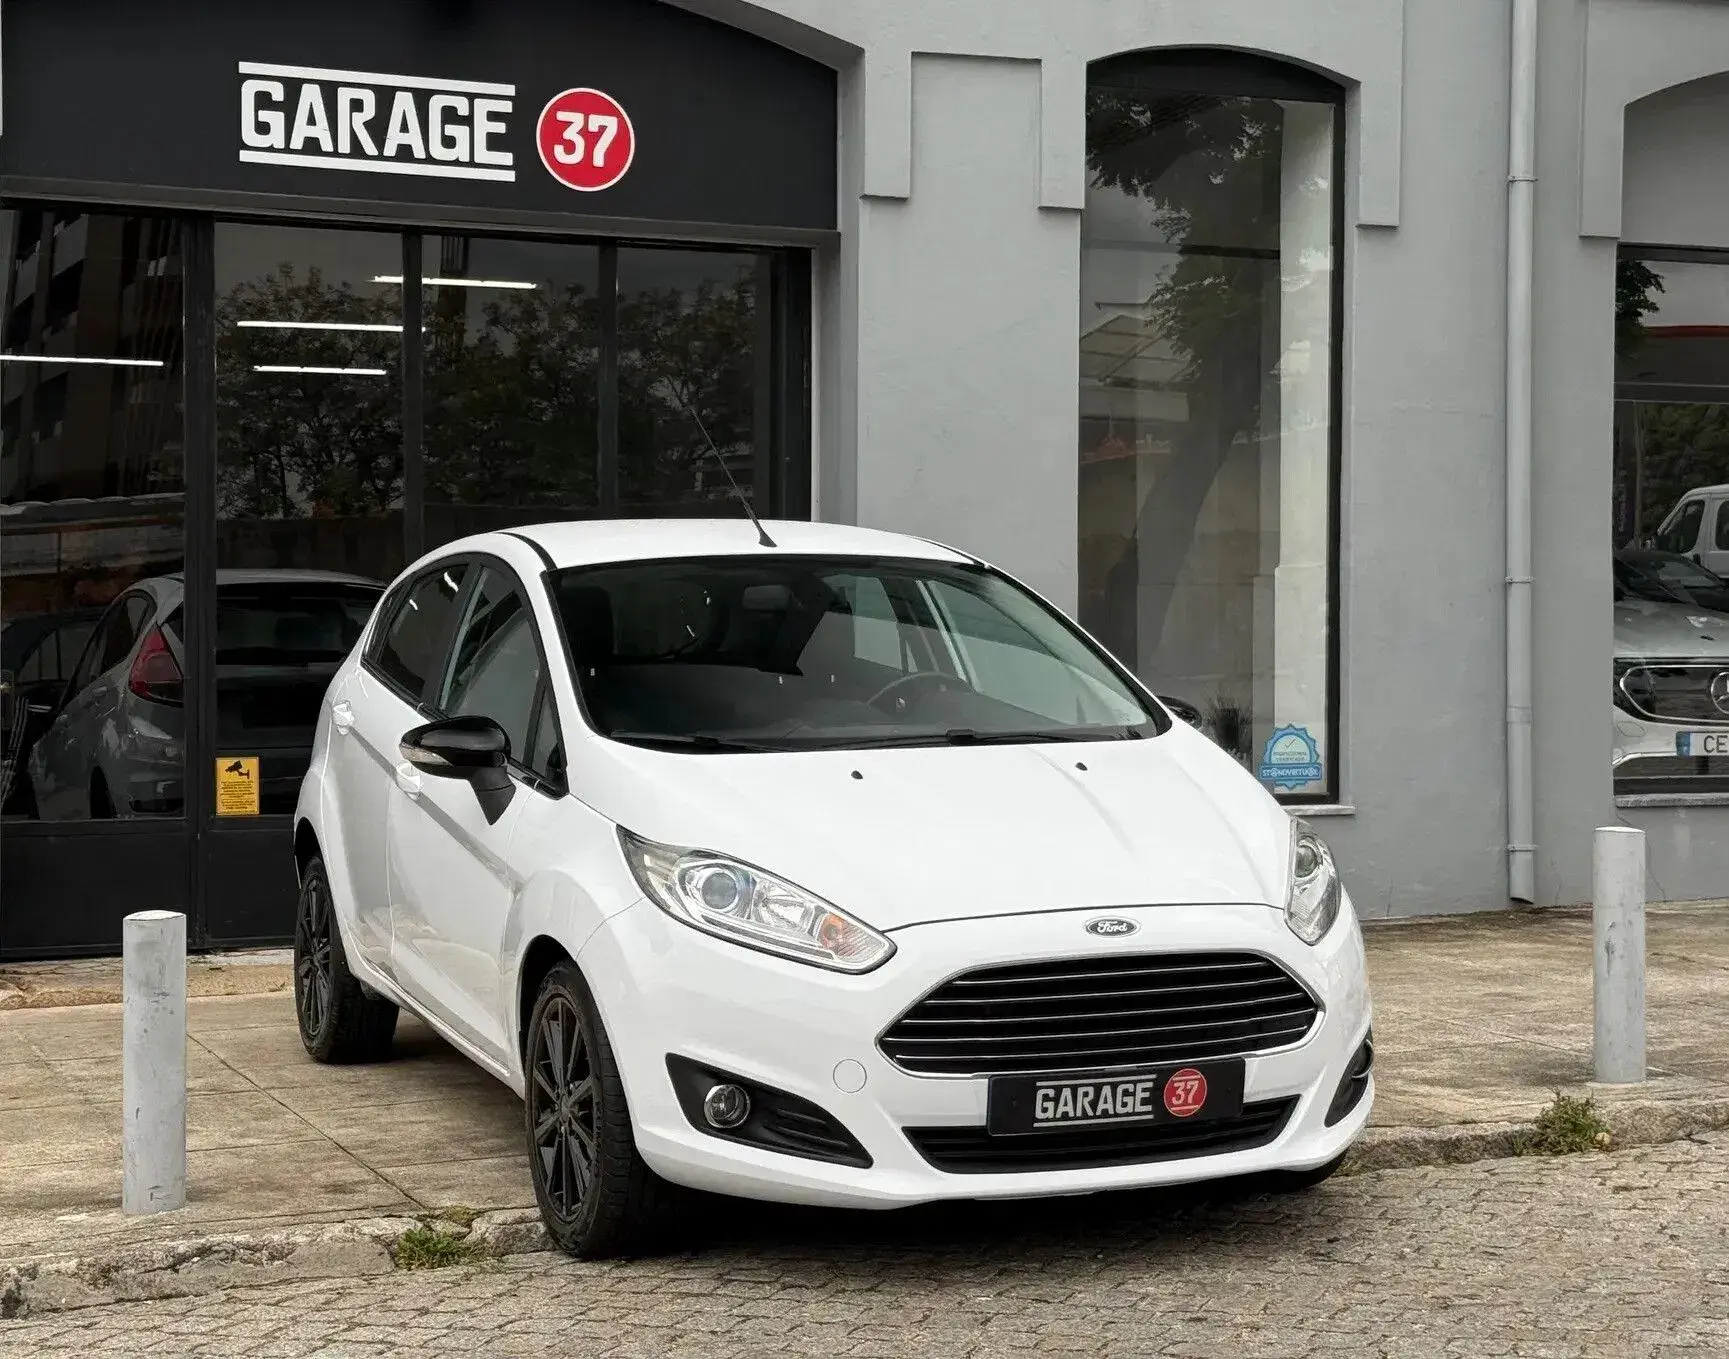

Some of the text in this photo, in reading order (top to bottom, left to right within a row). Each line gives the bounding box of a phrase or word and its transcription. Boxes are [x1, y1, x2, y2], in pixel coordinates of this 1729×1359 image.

[241, 79, 618, 168] GARAGE 37
[1703, 735, 1728, 753] CE
[1097, 920, 1128, 933] Ford
[1034, 1080, 1199, 1120] GARAGE 37
